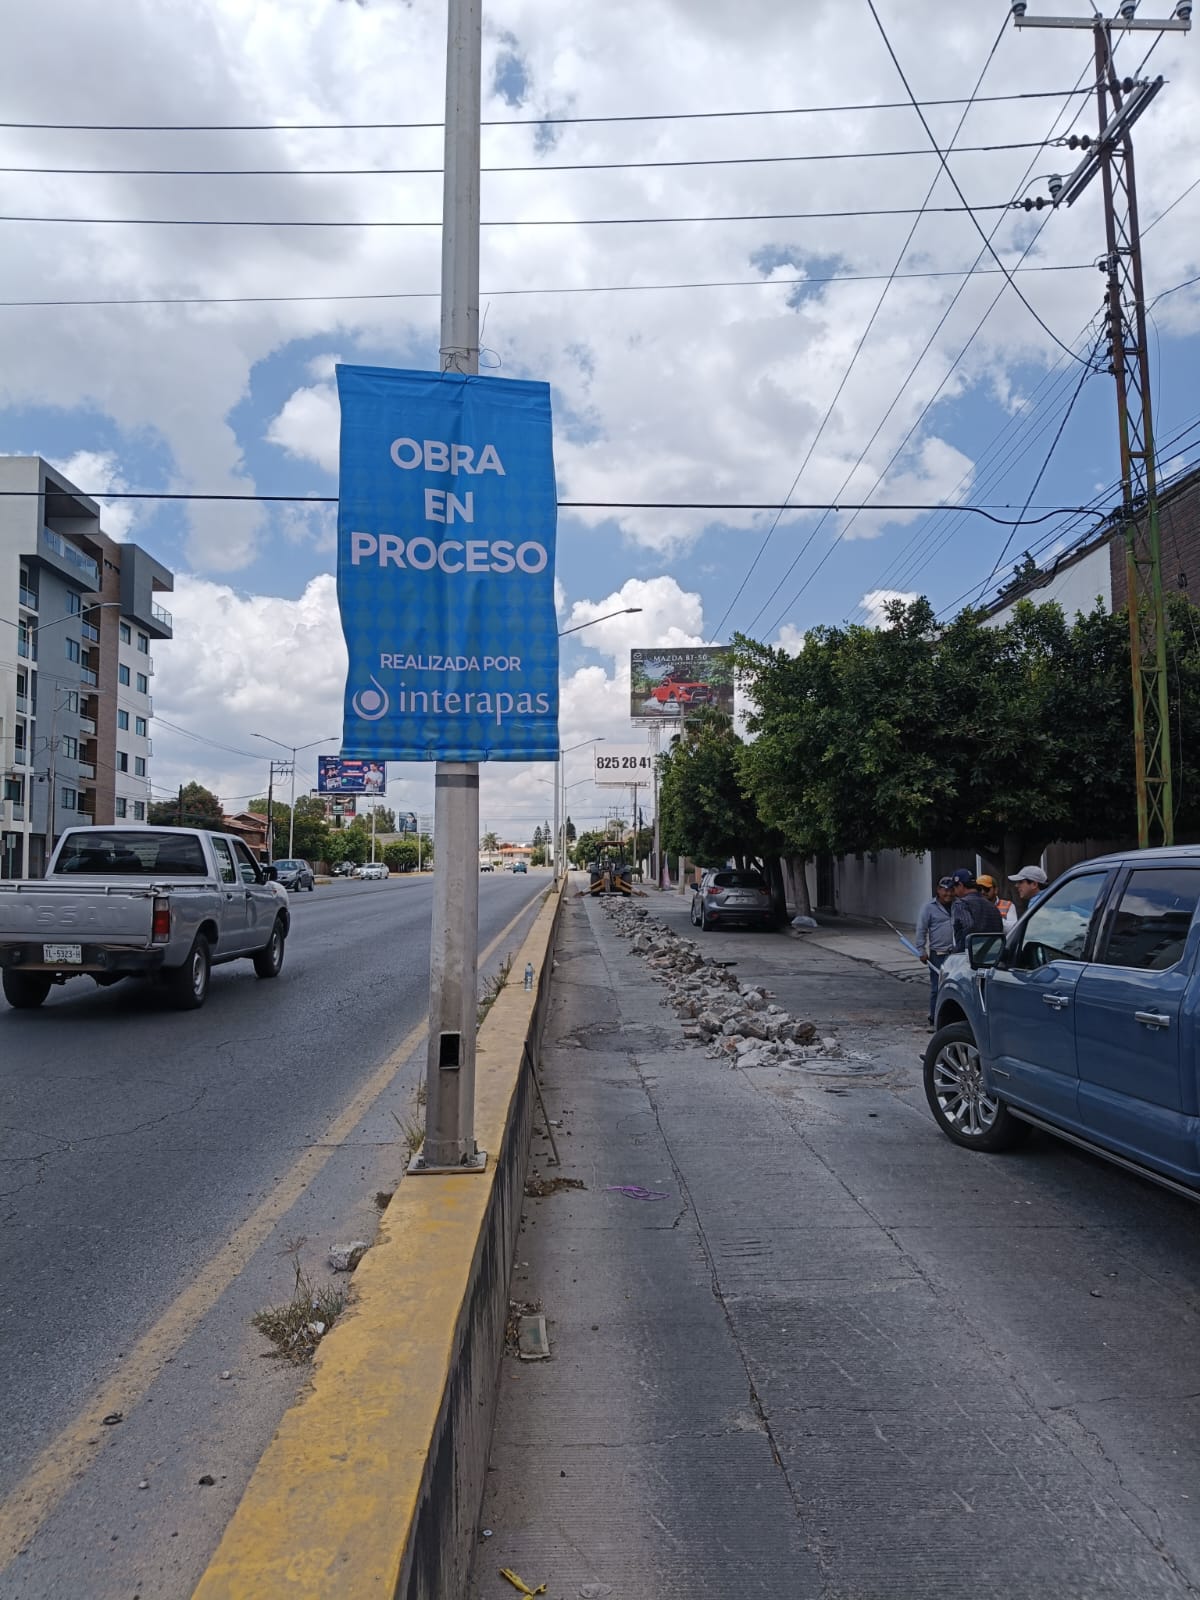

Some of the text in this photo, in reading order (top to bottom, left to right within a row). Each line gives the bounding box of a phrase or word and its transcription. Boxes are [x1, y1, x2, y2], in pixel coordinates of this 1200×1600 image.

[390, 437, 506, 476] OBRA
[424, 488, 474, 524] EN
[351, 531, 548, 574] PROCESO
[380, 653, 521, 671] REALIZADA POR
[399, 682, 550, 725] interapas
[596, 756, 651, 769] 825 28 41
